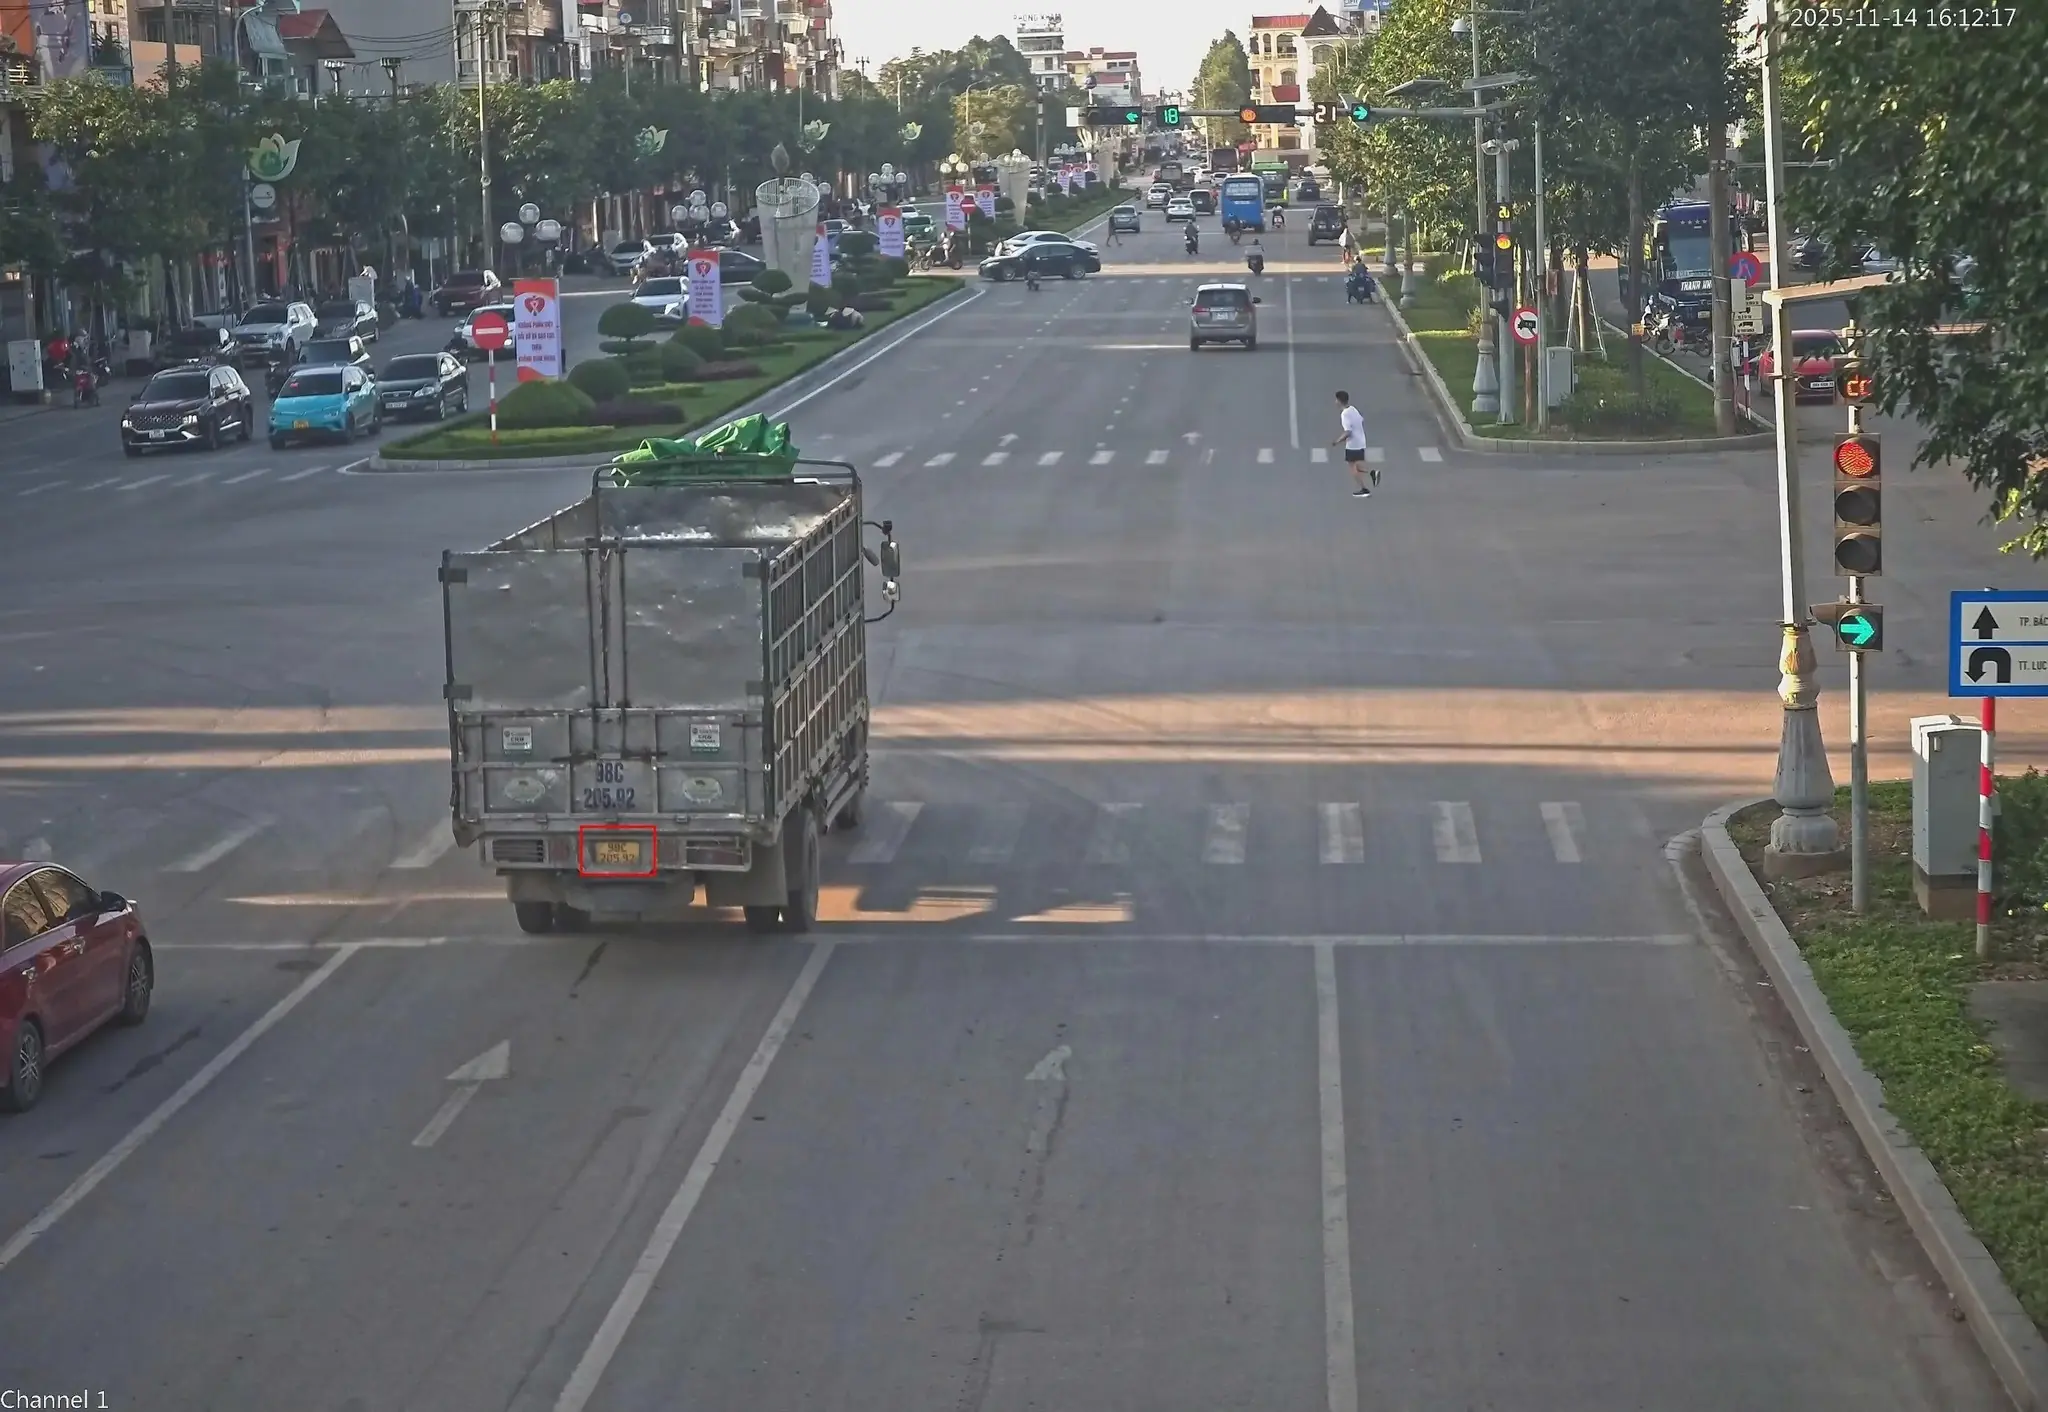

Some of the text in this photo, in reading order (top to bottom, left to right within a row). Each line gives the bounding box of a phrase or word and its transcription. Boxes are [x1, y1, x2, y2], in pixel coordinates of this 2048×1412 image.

[1163, 107, 1179, 124] 18
[1315, 104, 1337, 123] 21
[2019, 616, 2031, 627] TP.
[2018, 660, 2031, 671] TT.
[596, 761, 624, 783] 98C
[583, 787, 636, 809] 205.92
